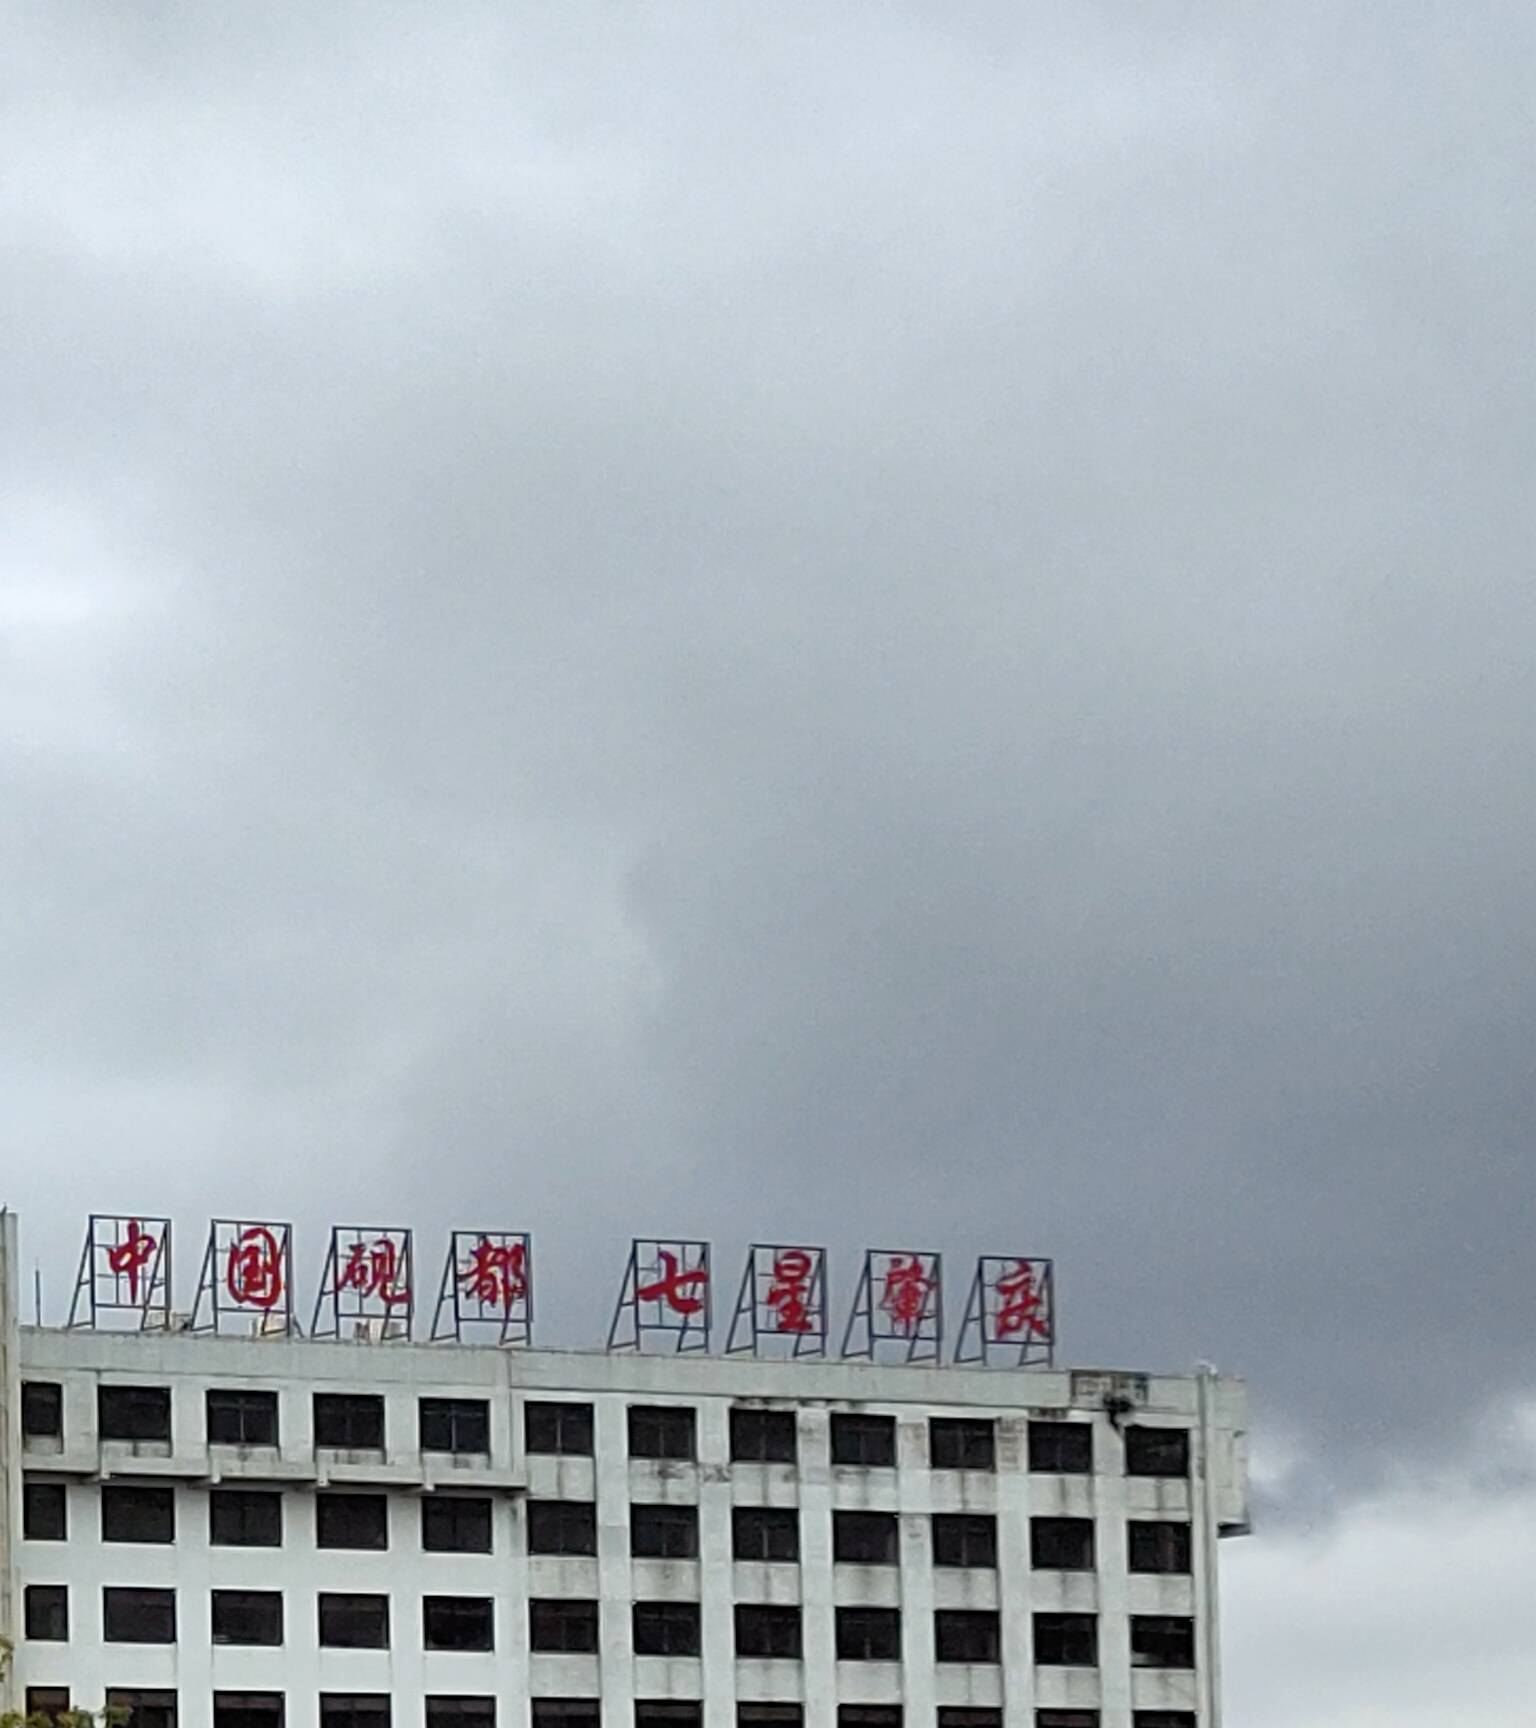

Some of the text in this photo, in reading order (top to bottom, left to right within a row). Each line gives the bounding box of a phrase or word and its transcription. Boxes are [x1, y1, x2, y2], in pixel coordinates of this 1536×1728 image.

[108, 1218, 1047, 1338] 中国砚都 七星肇庆
